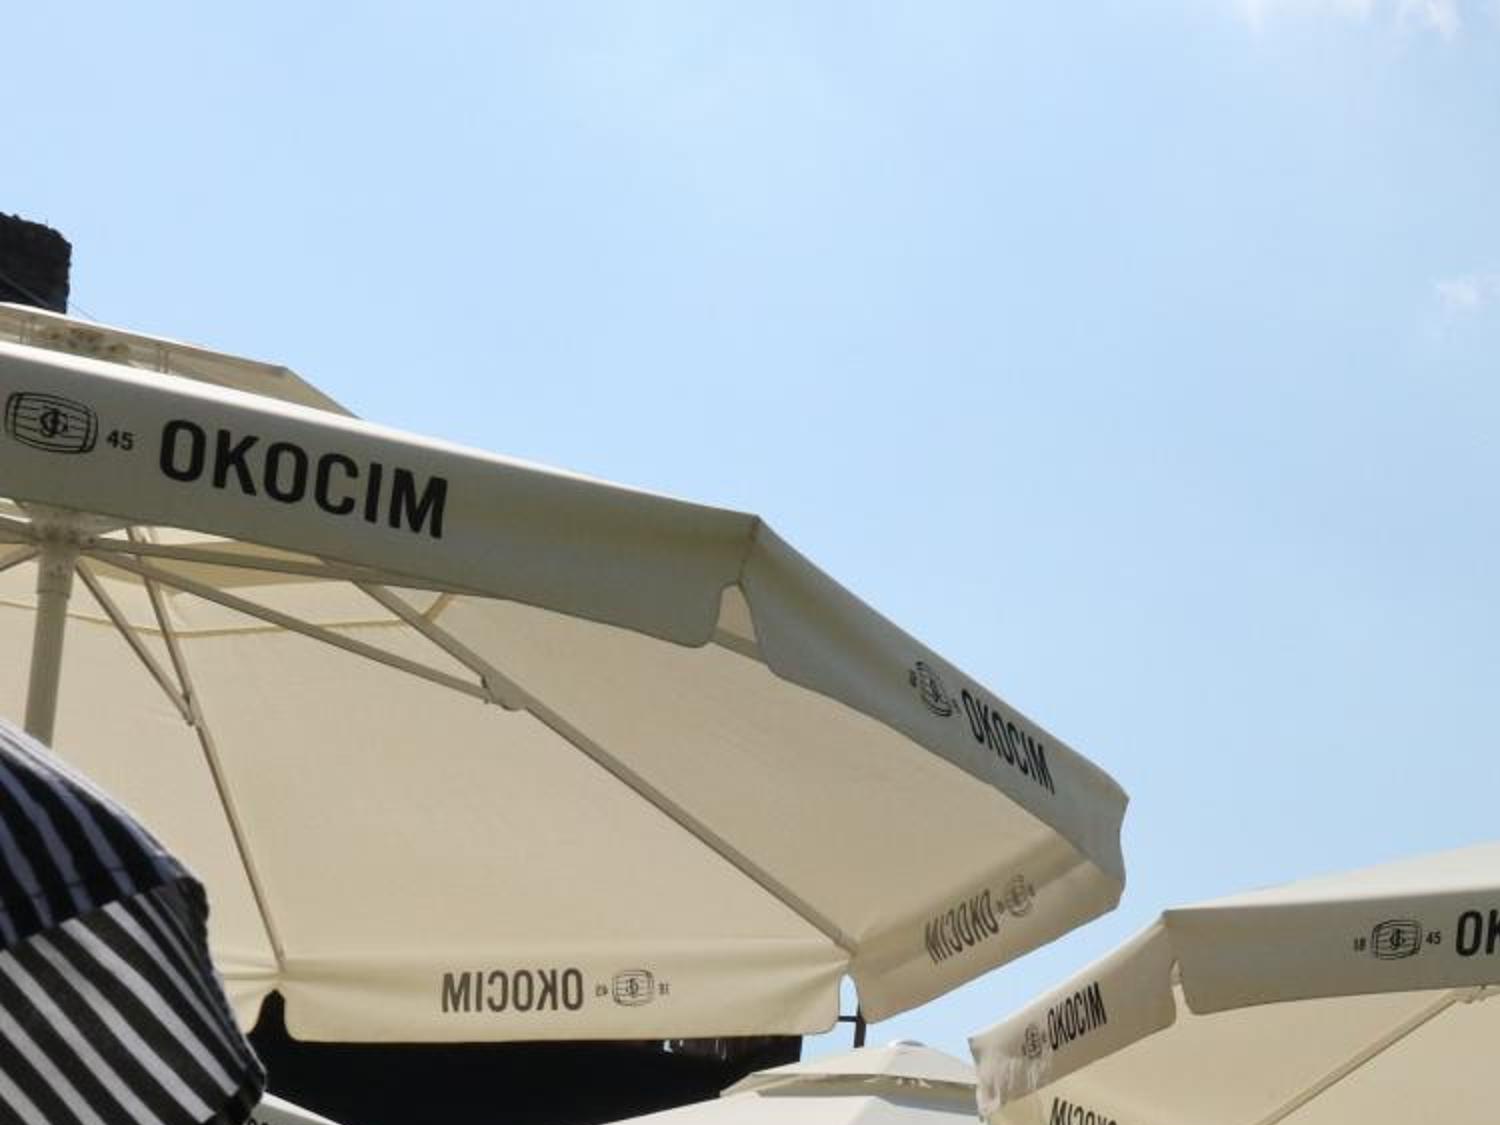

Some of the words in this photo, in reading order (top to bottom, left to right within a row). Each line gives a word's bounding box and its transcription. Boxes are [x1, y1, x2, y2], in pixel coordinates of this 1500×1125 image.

[106, 429, 135, 452] 45
[159, 418, 449, 540] OKOCIM
[961, 689, 1055, 796] OKOCIM
[1425, 931, 1442, 945] 45
[1047, 981, 1108, 1051] OKOCIM
